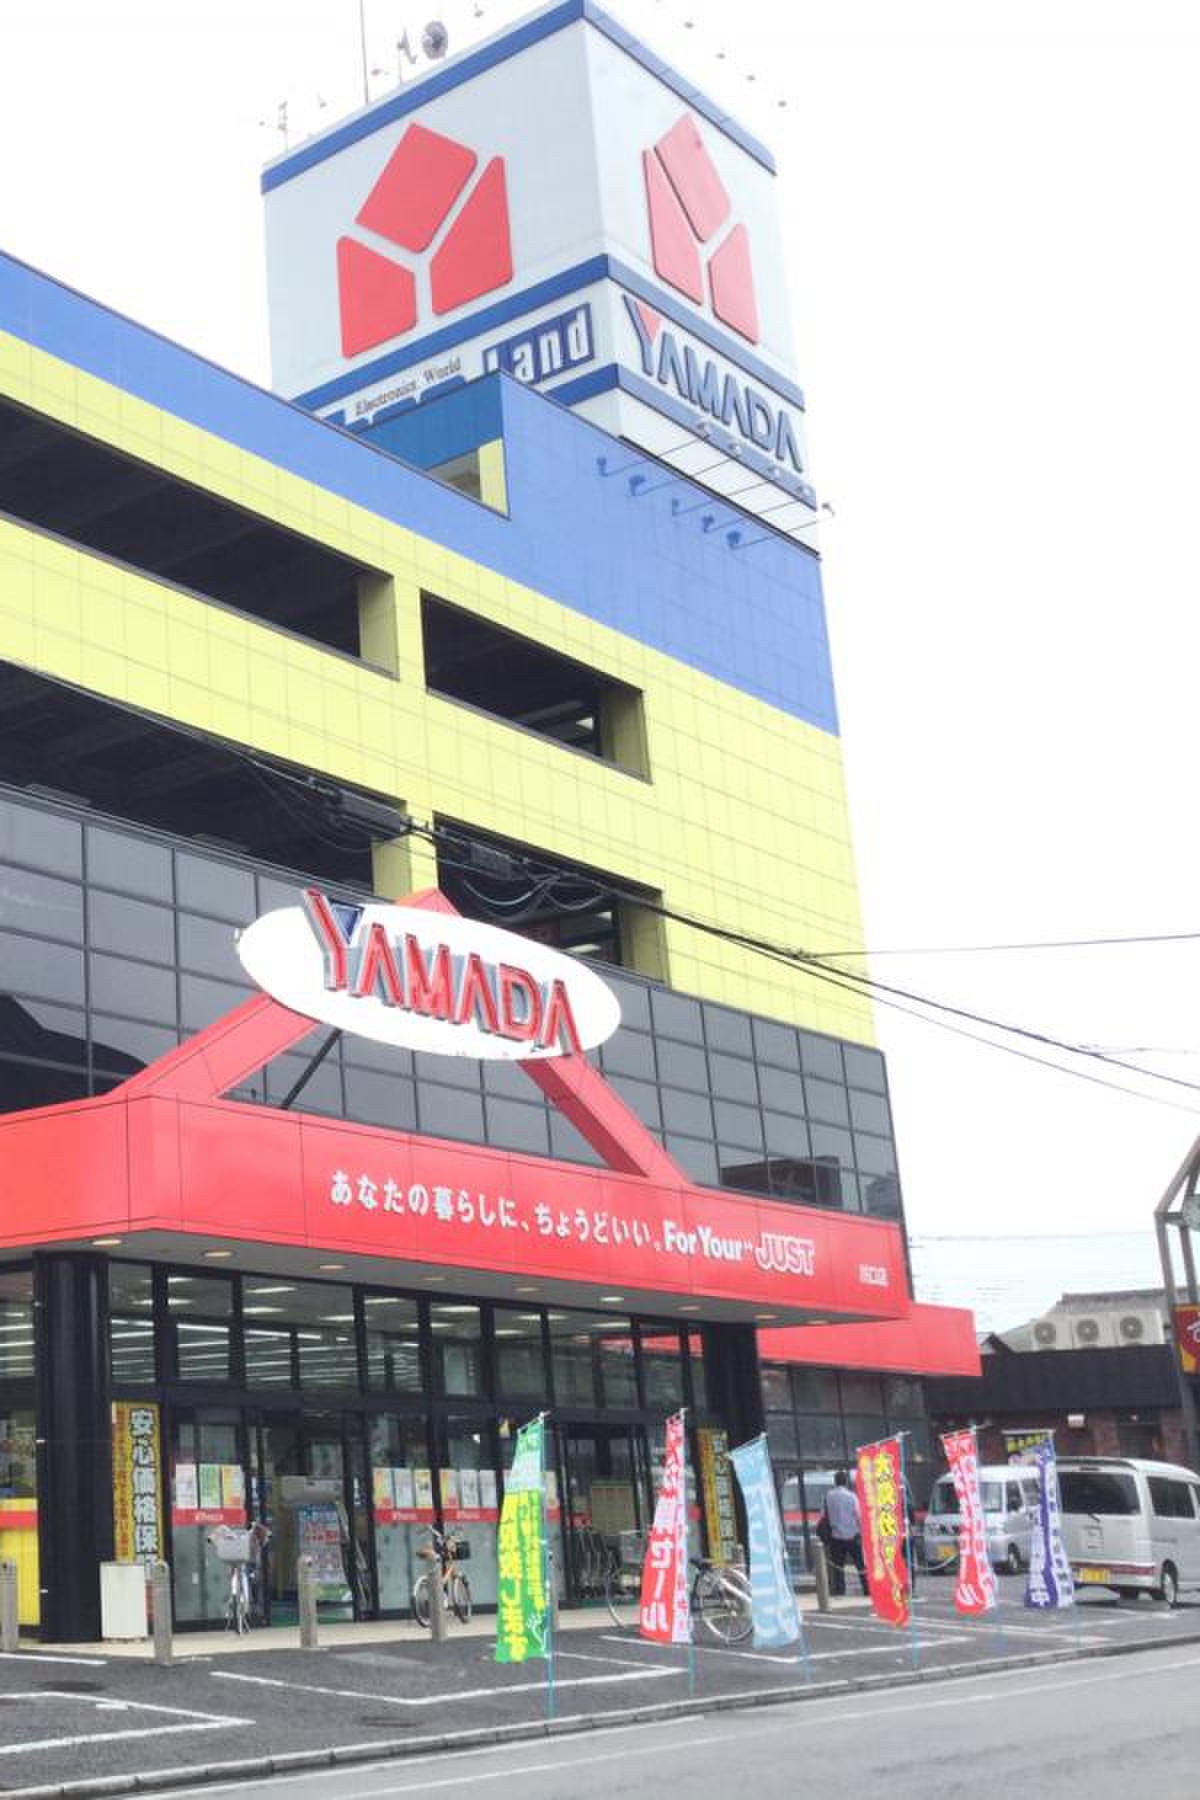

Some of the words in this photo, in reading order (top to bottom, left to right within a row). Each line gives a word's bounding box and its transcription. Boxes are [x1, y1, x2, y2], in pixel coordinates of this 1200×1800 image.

[622, 293, 804, 474] YAMADA
[303, 886, 585, 1058] YAMADA
[663, 1219, 696, 1257] For
[696, 1225, 743, 1262] Your
[755, 1231, 816, 1277] JUST
